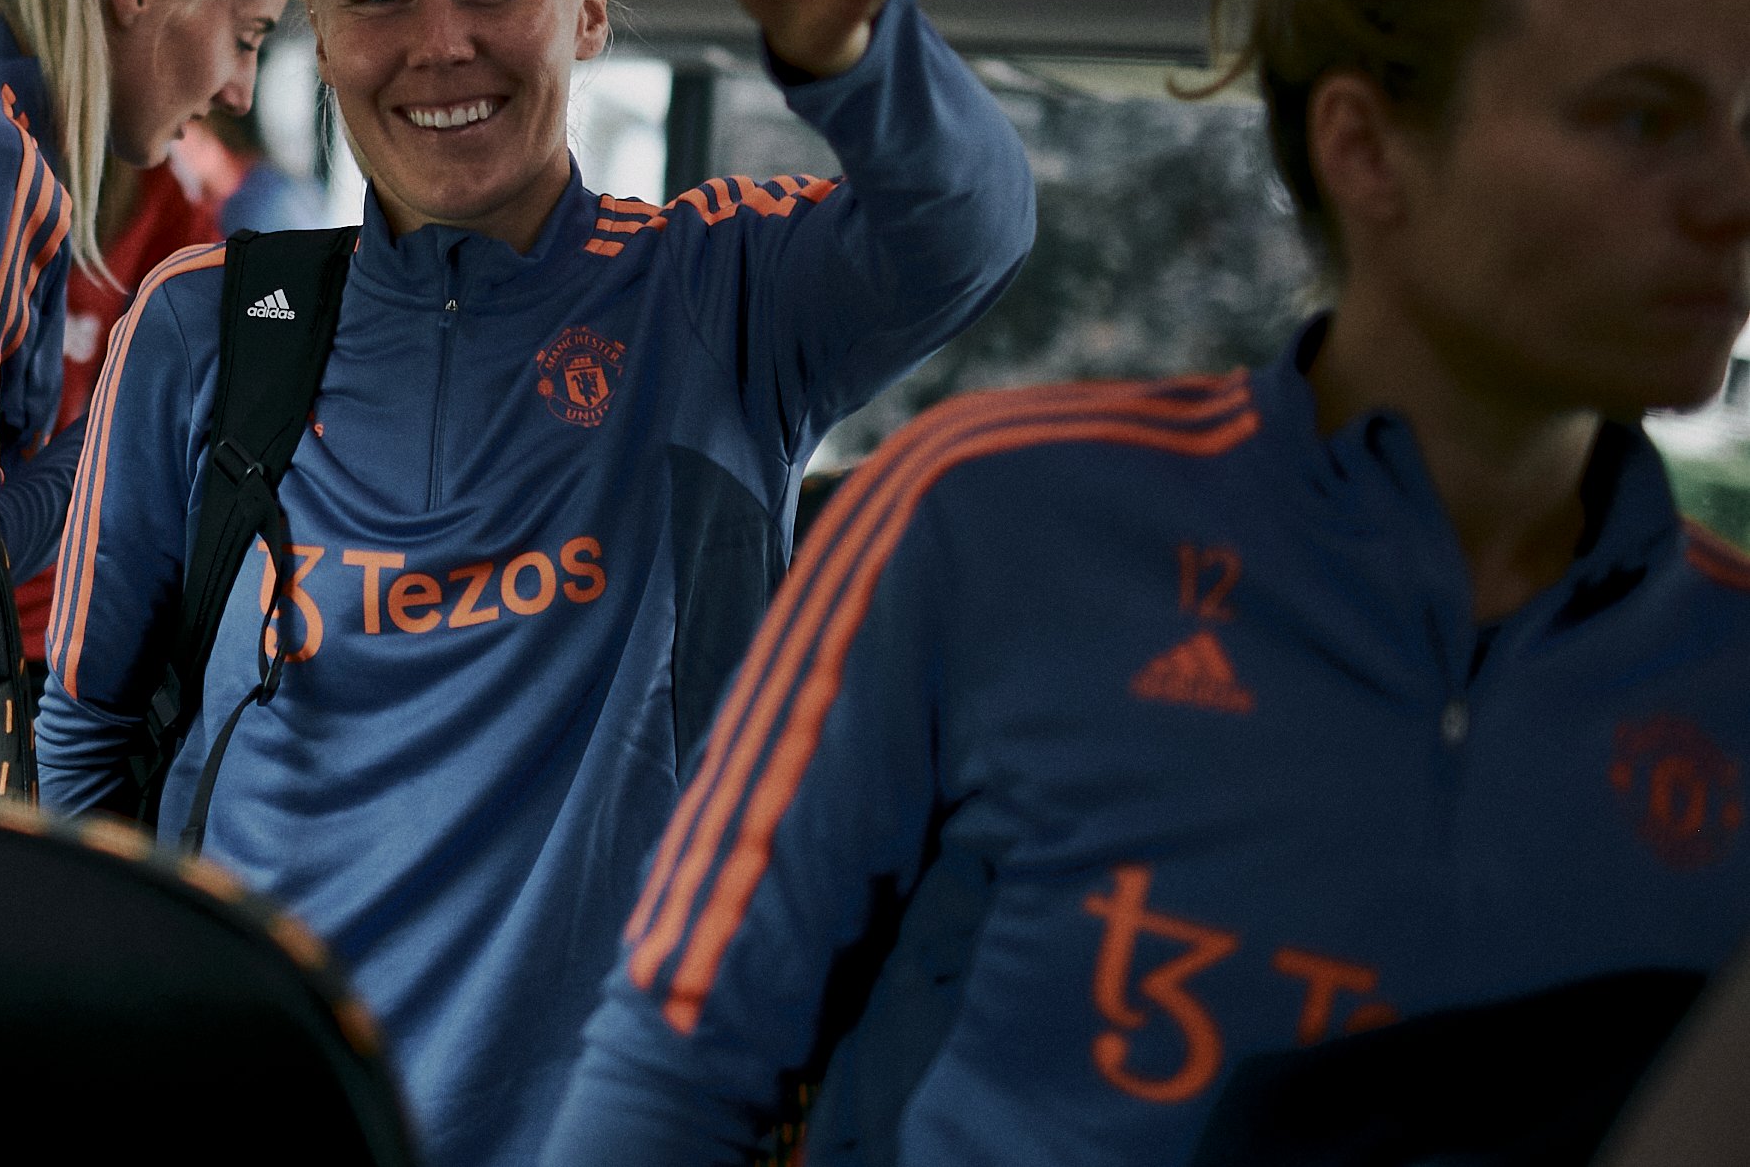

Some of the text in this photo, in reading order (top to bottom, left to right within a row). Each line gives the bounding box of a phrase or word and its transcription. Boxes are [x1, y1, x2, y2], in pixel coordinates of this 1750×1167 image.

[247, 306, 296, 320] adidas
[545, 335, 620, 370] MANCHESTER
[341, 535, 607, 636] Tezos
[1173, 540, 1242, 622] 12
